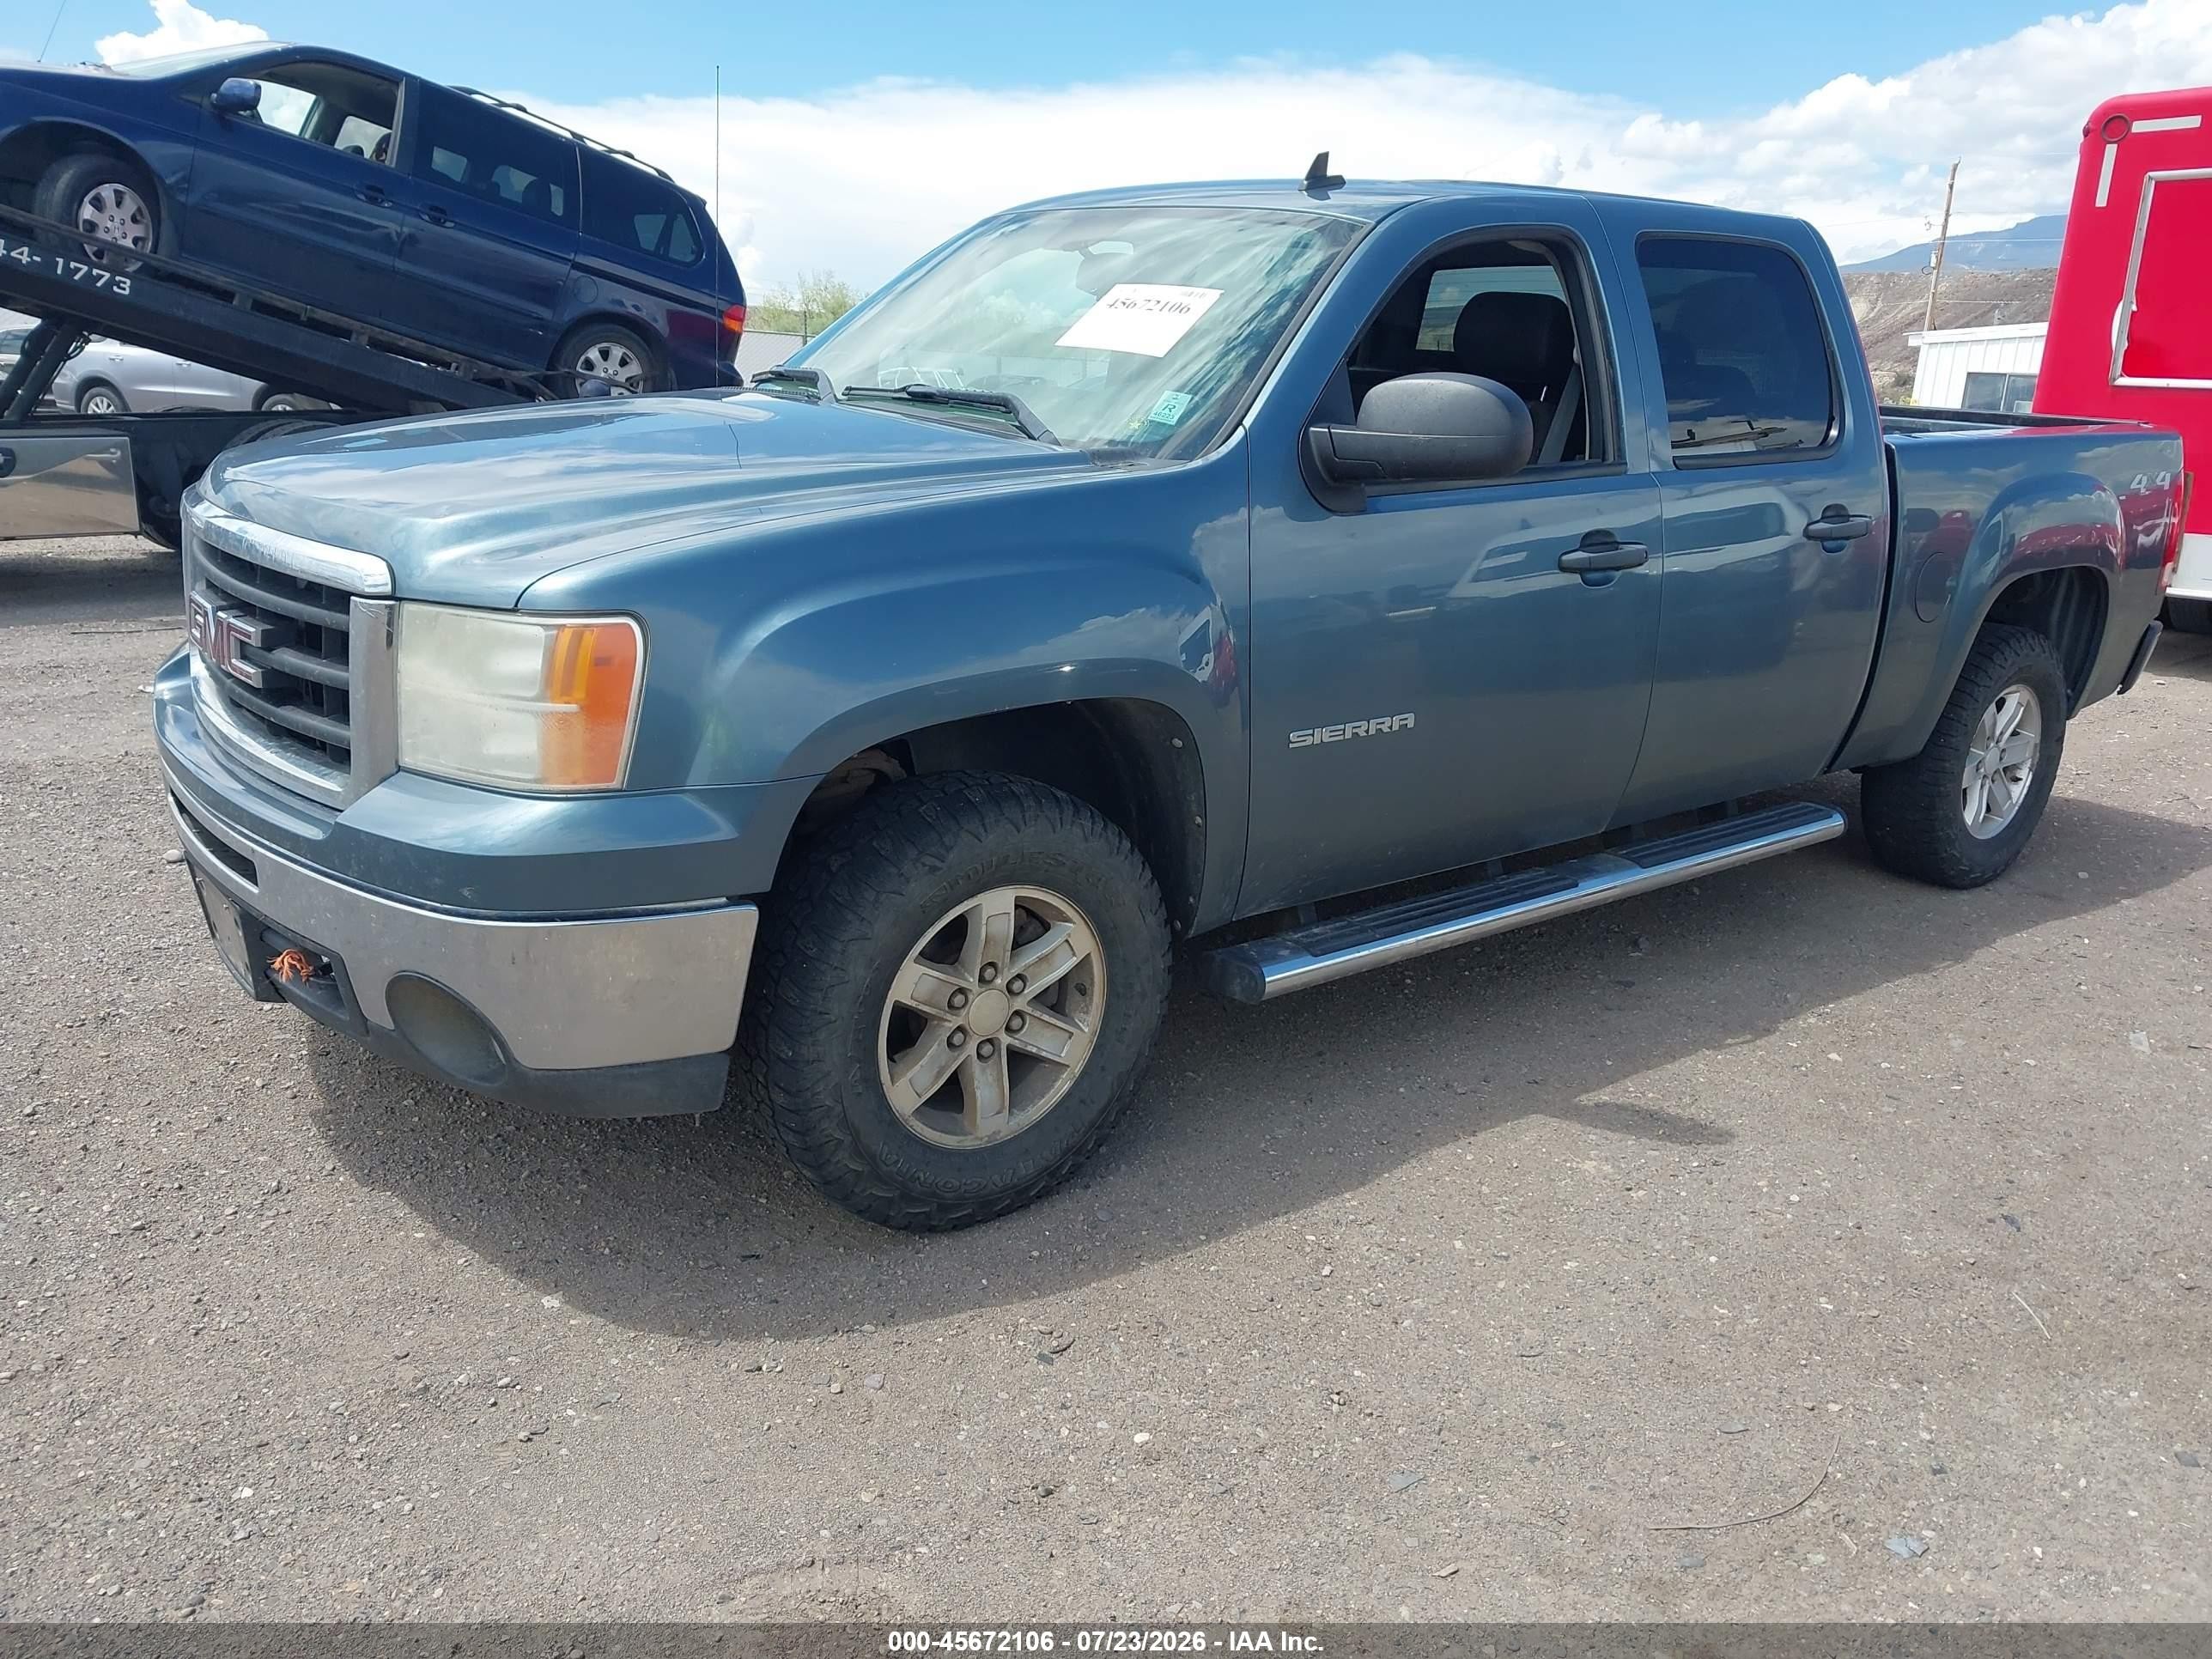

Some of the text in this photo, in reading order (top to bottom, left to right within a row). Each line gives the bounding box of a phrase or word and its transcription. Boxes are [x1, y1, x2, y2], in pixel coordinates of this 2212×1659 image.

[56, 257, 131, 295] 1773
[1106, 297, 1192, 315] 45672106
[1162, 404, 1176, 413] R
[189, 591, 262, 688] GMC
[1289, 712, 1415, 749] SIERRA
